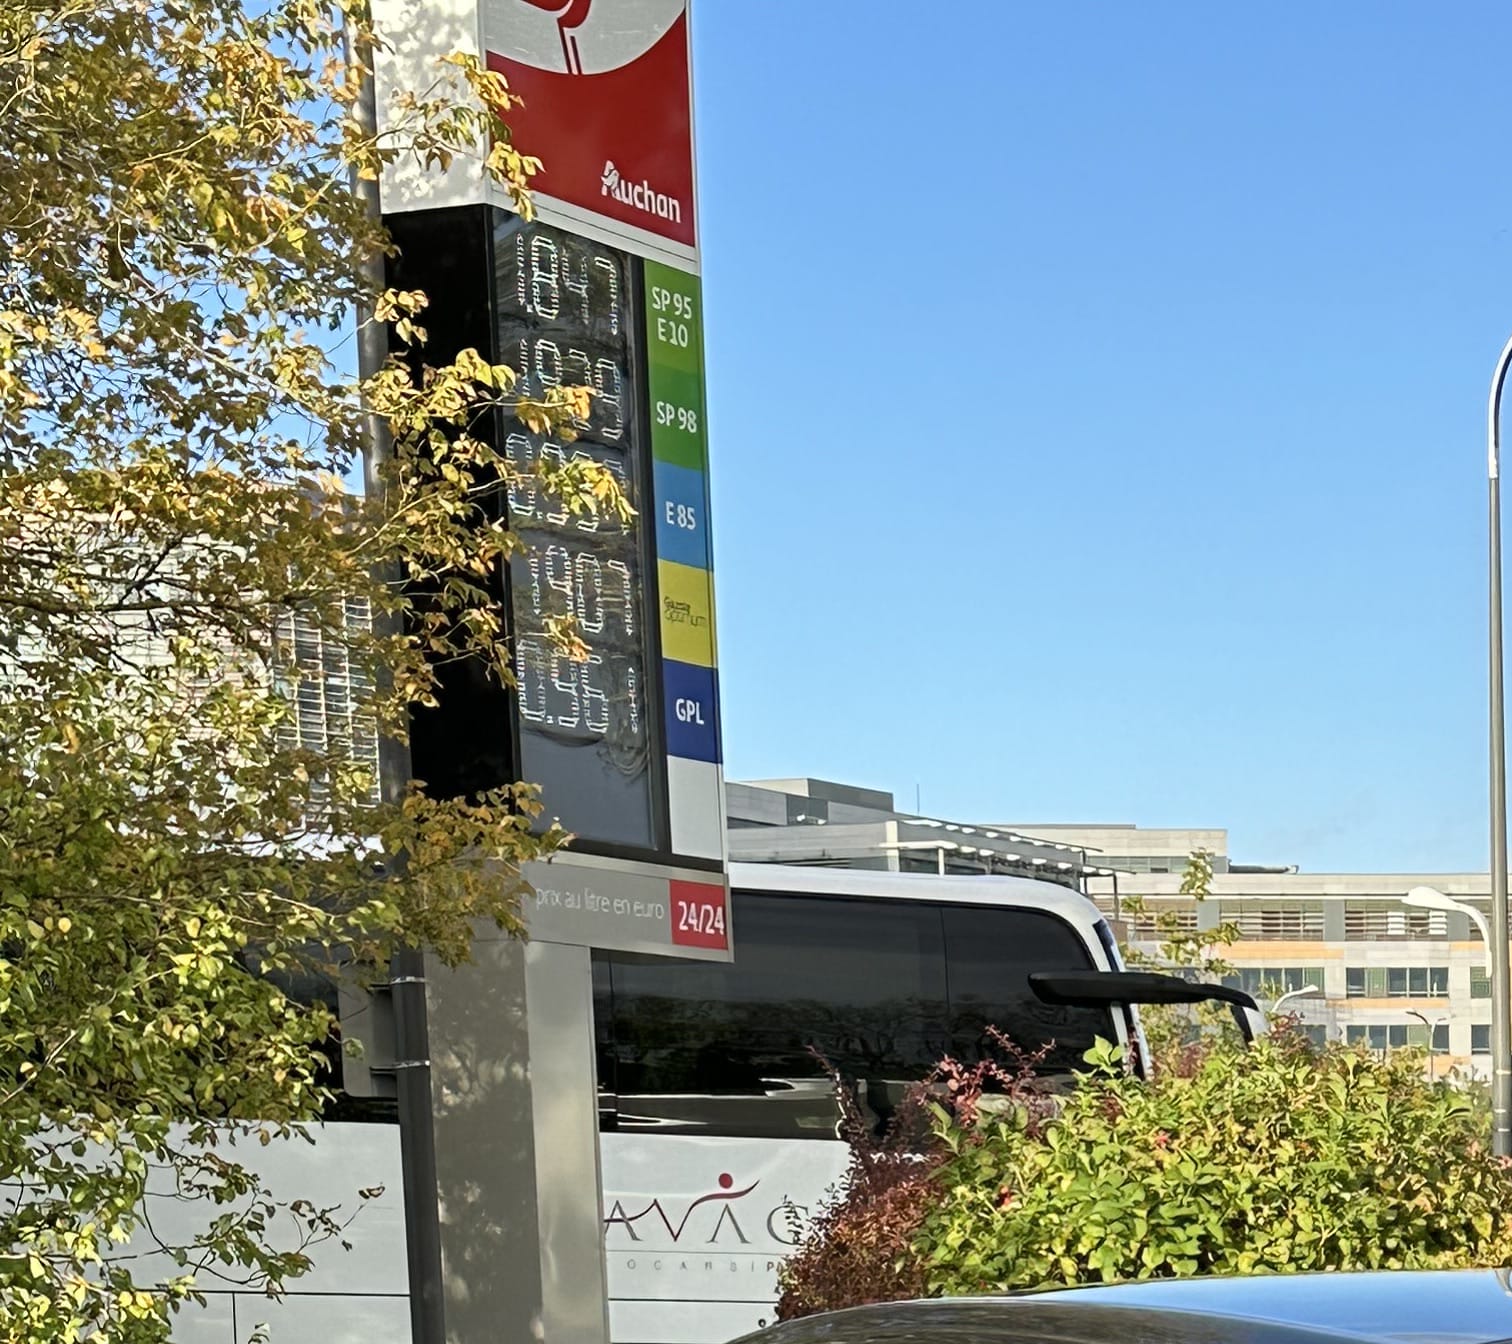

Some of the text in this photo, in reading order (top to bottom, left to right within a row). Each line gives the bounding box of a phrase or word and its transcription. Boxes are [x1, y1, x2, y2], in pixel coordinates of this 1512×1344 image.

[600, 160, 681, 224] Auchan
[651, 286, 692, 319] SP 95
[656, 401, 697, 433] SP 98
[675, 698, 705, 725] GPL
[565, 891, 581, 909] au
[612, 898, 631, 915] en
[633, 902, 665, 920] euro
[677, 901, 726, 936] 24/24
